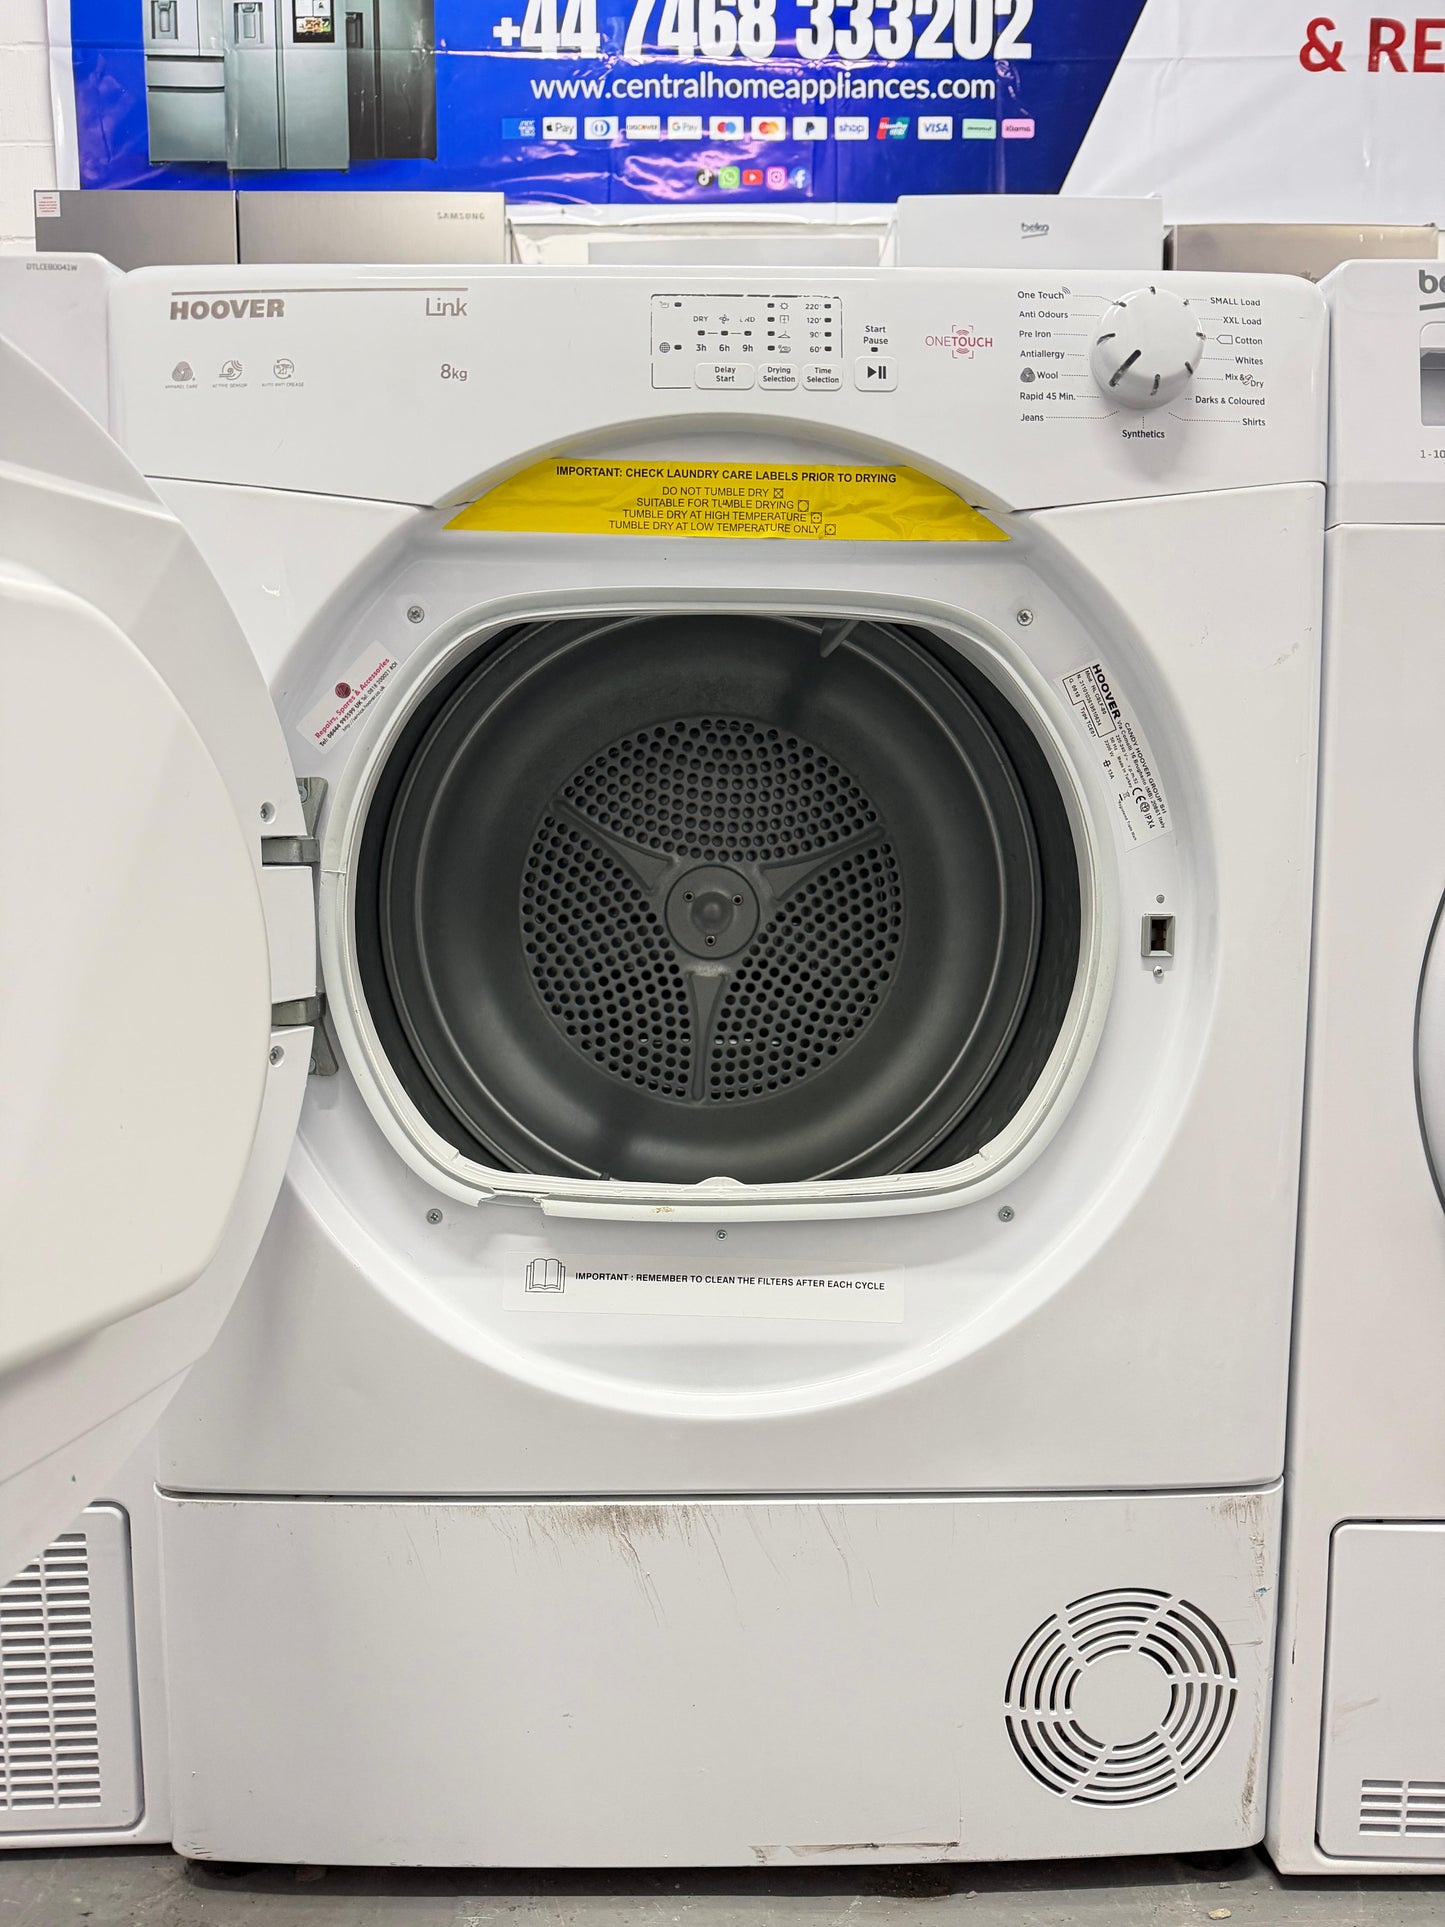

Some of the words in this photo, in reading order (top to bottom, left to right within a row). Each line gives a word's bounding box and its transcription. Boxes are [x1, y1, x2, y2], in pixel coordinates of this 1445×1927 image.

[493, 0, 600, 60] +44
[623, 0, 776, 60] 7468
[795, 0, 1032, 60] 333202
[1300, 17, 1347, 73] &
[531, 72, 996, 104] www.centralhomeappliances.com
[555, 123, 574, 135] Pay
[839, 123, 864, 134] shop
[924, 123, 949, 133] VISA
[436, 212, 486, 220] SAMSUNG
[1021, 222, 1050, 232] beko
[1018, 291, 1035, 300] One
[1038, 291, 1064, 300] Touch
[1210, 297, 1238, 305] SMALL
[169, 298, 286, 321] HOOVER
[425, 297, 468, 317] Link
[1019, 310, 1036, 318] Anti
[1038, 310, 1069, 318] Odours
[1019, 330, 1032, 338] Pre
[1035, 330, 1051, 338] Iron
[863, 337, 888, 345] Pause
[925, 336, 993, 347] ONETOUCH
[1235, 337, 1263, 345] Cotton
[742, 344, 753, 352] 9h
[1020, 350, 1065, 359] Antiallergy
[1235, 357, 1263, 365] Whites
[440, 364, 468, 381] 8kg
[715, 366, 736, 374] Delay
[1037, 371, 1058, 379] Wool
[763, 375, 795, 383] Selection
[1251, 380, 1264, 388] Dry
[1020, 393, 1043, 401] Rapid
[1195, 396, 1218, 404] Darks
[1228, 397, 1265, 405] Coloured
[1021, 414, 1044, 422] Jeans
[1242, 418, 1266, 426] Shirts
[1122, 430, 1165, 438] Synthetics
[557, 466, 622, 477] IMPORTANT:
[626, 468, 664, 478] CHECK
[667, 469, 719, 478] LAUNDRY
[722, 471, 752, 479] CARE
[756, 472, 798, 481] LABELS
[802, 473, 834, 482] PRIOR
[837, 474, 852, 482] TO
[856, 474, 896, 483] DRYING
[663, 487, 677, 495] DO
[681, 487, 701, 495] NOT
[704, 487, 745, 496] TUMBLE
[748, 489, 769, 497] DRY
[637, 498, 684, 507] SUITABLE
[688, 499, 709, 507] FOR
[712, 499, 750, 508] TUMBLE
[756, 501, 794, 509] DRYING
[623, 510, 663, 518] TUMBLE
[667, 510, 687, 519] DRY
[690, 511, 702, 519] AT
[704, 511, 730, 519] HIGH
[733, 512, 806, 522] TEMPERATURE
[609, 521, 649, 529] TUMBLE
[653, 522, 674, 530] DRY
[676, 522, 688, 530] AT
[691, 523, 714, 531] LOW
[716, 523, 790, 532] TEMPERATURE
[794, 525, 820, 533] ONLY
[1092, 664, 1121, 719] HOOVER
[314, 716, 338, 739] Repairs,
[335, 695, 356, 716] Spares
[359, 658, 389, 690] Accessories
[1080, 706, 1088, 720] Type
[319, 738, 328, 746] Tel:
[354, 700, 362, 708] UK
[1130, 751, 1136, 759] 16
[1124, 722, 1138, 746] CANDY
[1135, 747, 1151, 777] HOOVER
[1148, 777, 1162, 802] GROUP
[1124, 773, 1132, 788] Turkey
[1144, 812, 1155, 829] IPX4
[576, 1272, 628, 1280] IMPORTANT
[636, 1274, 688, 1282] REMEMBER
[690, 1275, 702, 1283] TO
[705, 1276, 735, 1284] CLEAN
[758, 1278, 793, 1286] FILTERS
[796, 1279, 825, 1287] AFTER
[828, 1280, 852, 1288] EACH
[855, 1282, 885, 1290] CYCLE
